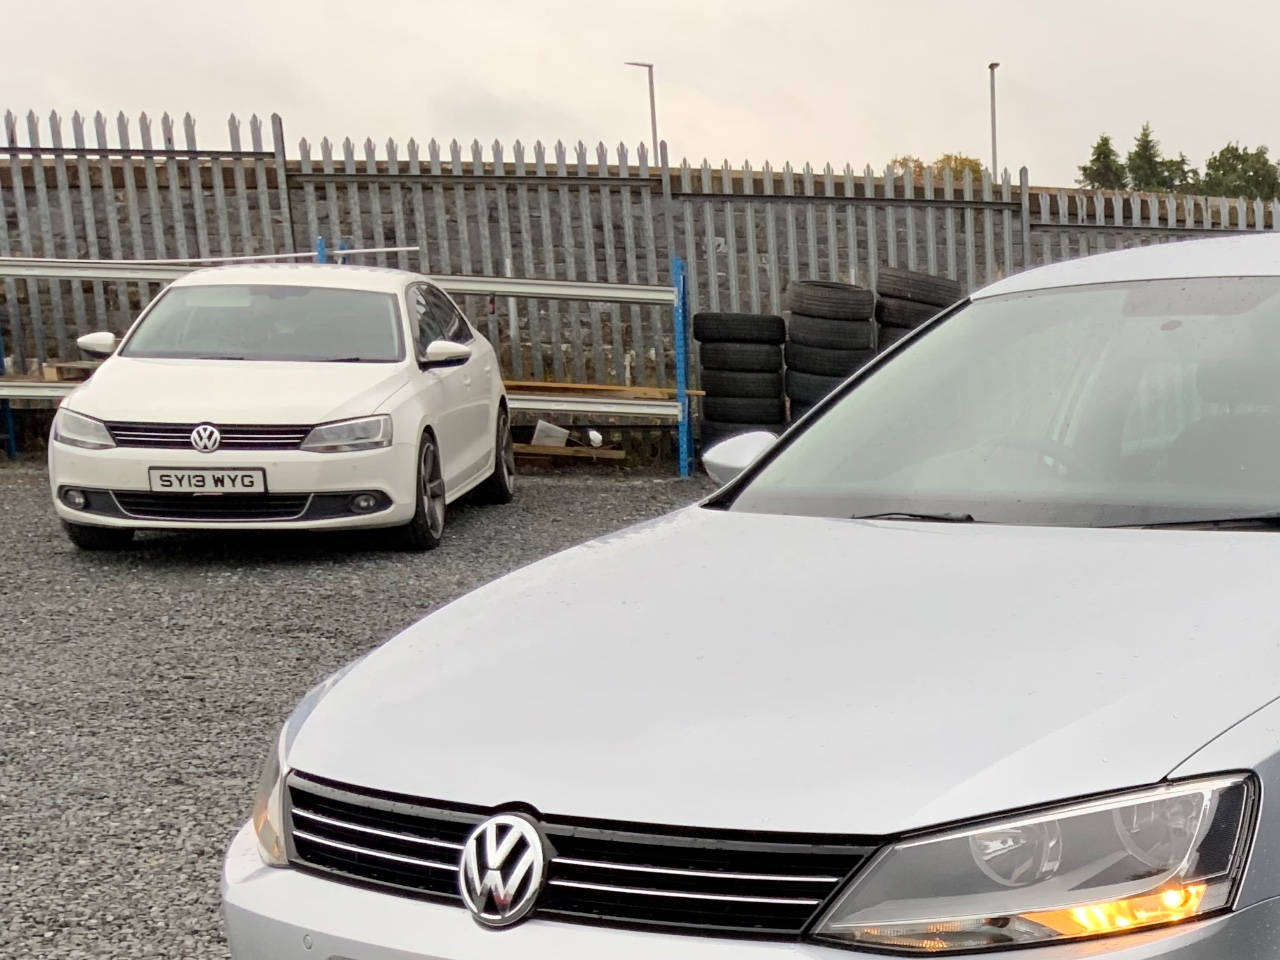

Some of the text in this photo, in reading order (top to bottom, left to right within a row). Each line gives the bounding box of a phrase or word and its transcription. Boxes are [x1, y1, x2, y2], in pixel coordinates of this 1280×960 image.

[191, 425, 221, 453] VW
[160, 474, 255, 488] SY13 WYG
[460, 814, 543, 925] VW
